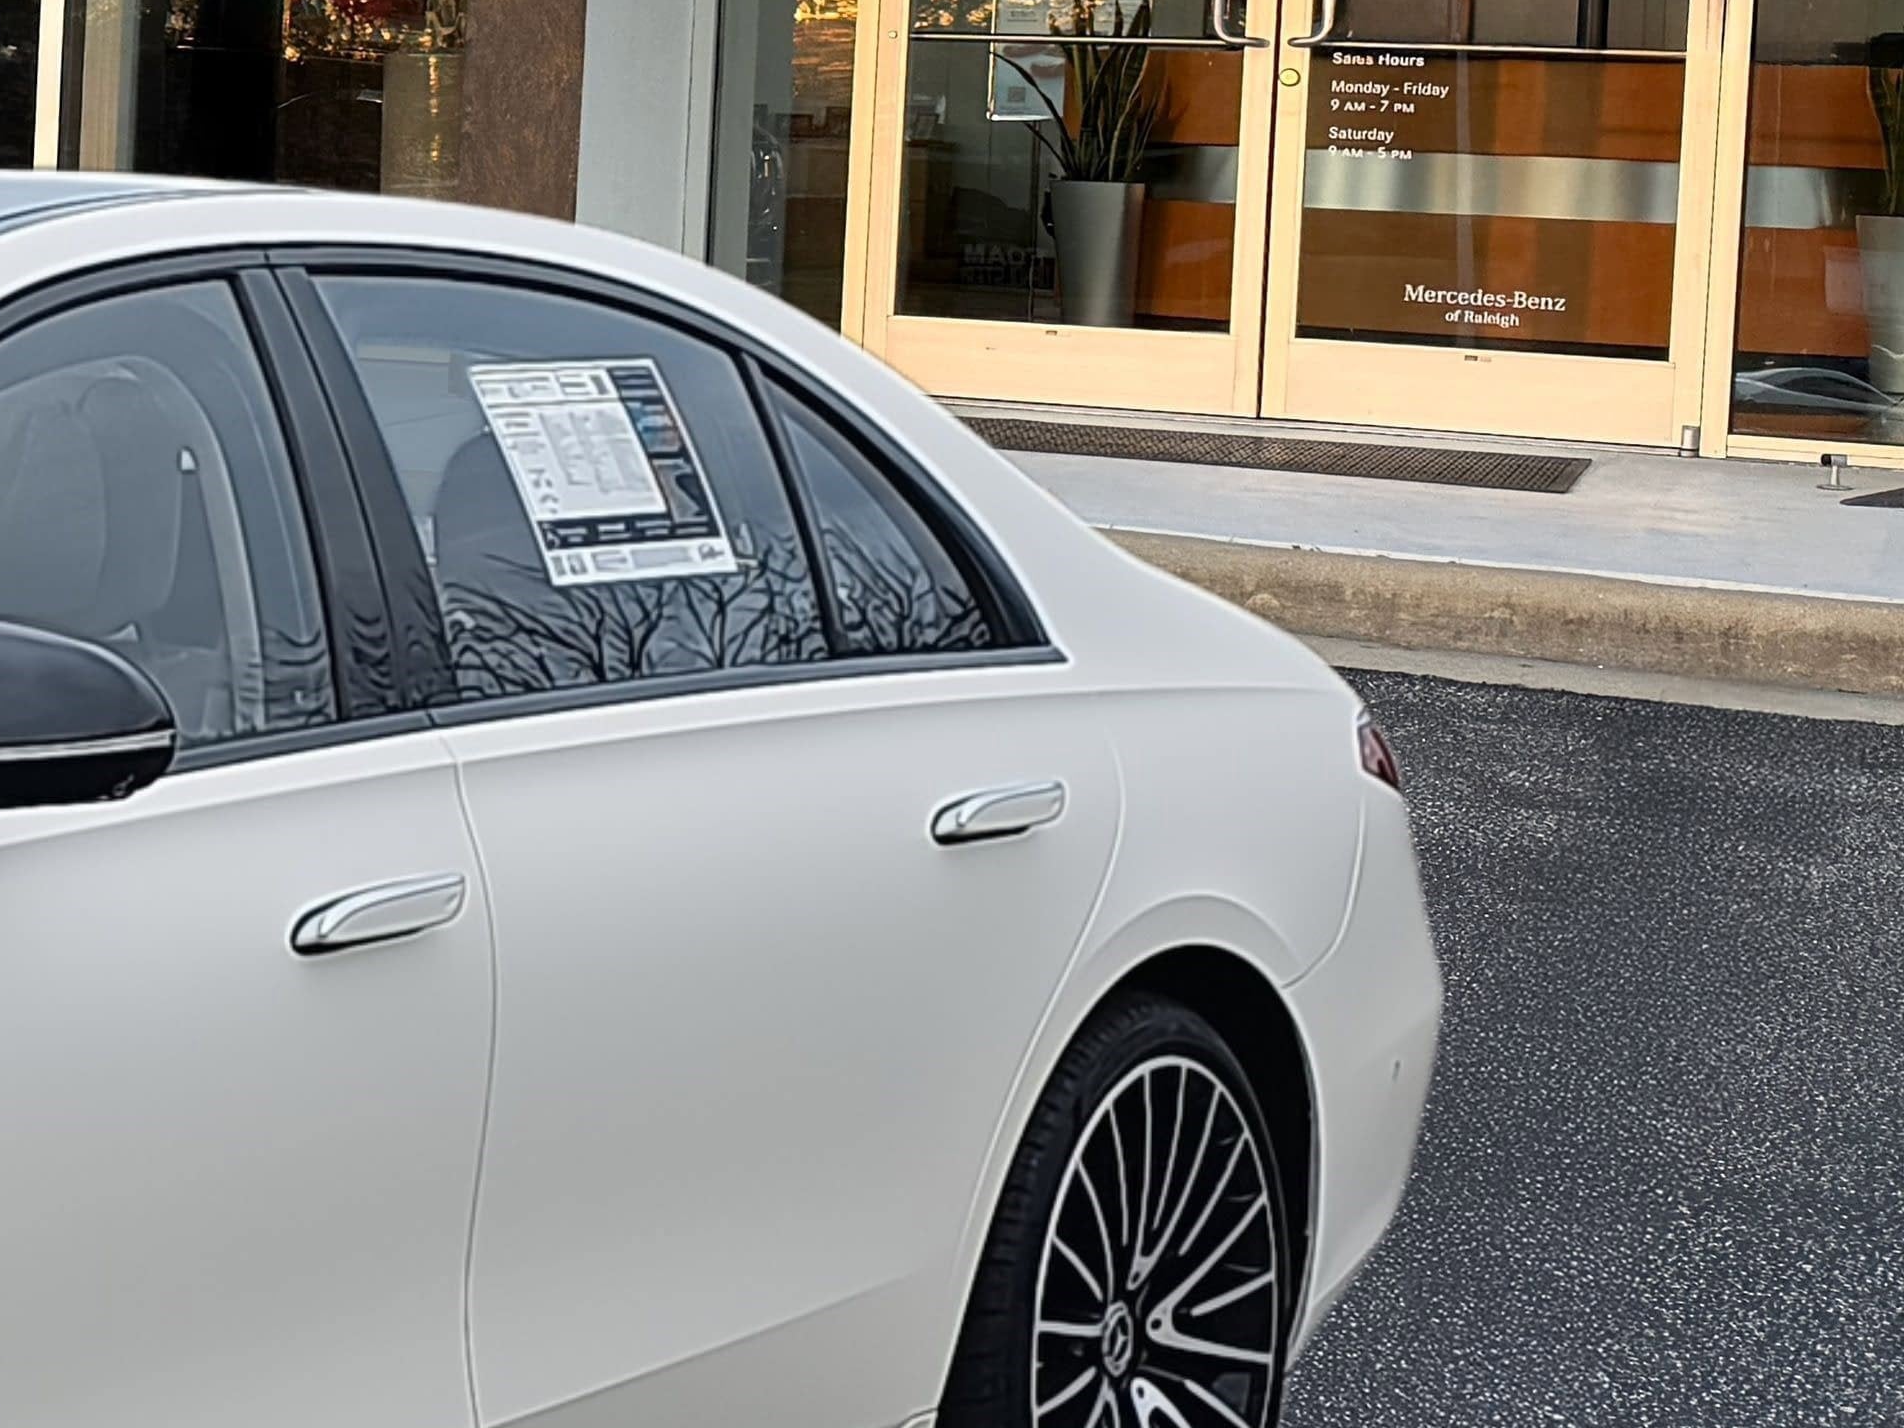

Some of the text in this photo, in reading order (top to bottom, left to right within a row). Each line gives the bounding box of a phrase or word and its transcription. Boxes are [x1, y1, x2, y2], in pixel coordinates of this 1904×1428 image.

[1377, 53, 1425, 67] Hours
[1331, 80, 1390, 97] Monday
[1403, 82, 1449, 98] Friday
[1330, 98, 1340, 112] 9
[1343, 101, 1366, 112] AM
[1379, 100, 1389, 112] 7
[1393, 103, 1415, 113] PM
[1328, 126, 1394, 144] Saturday
[1328, 145, 1337, 157] 9
[1342, 147, 1364, 158] AM
[1377, 146, 1387, 159] 5
[1391, 149, 1412, 160] PM
[1403, 283, 1566, 312] Mercedes-Benz
[1445, 309, 1520, 329] of Raleigh
